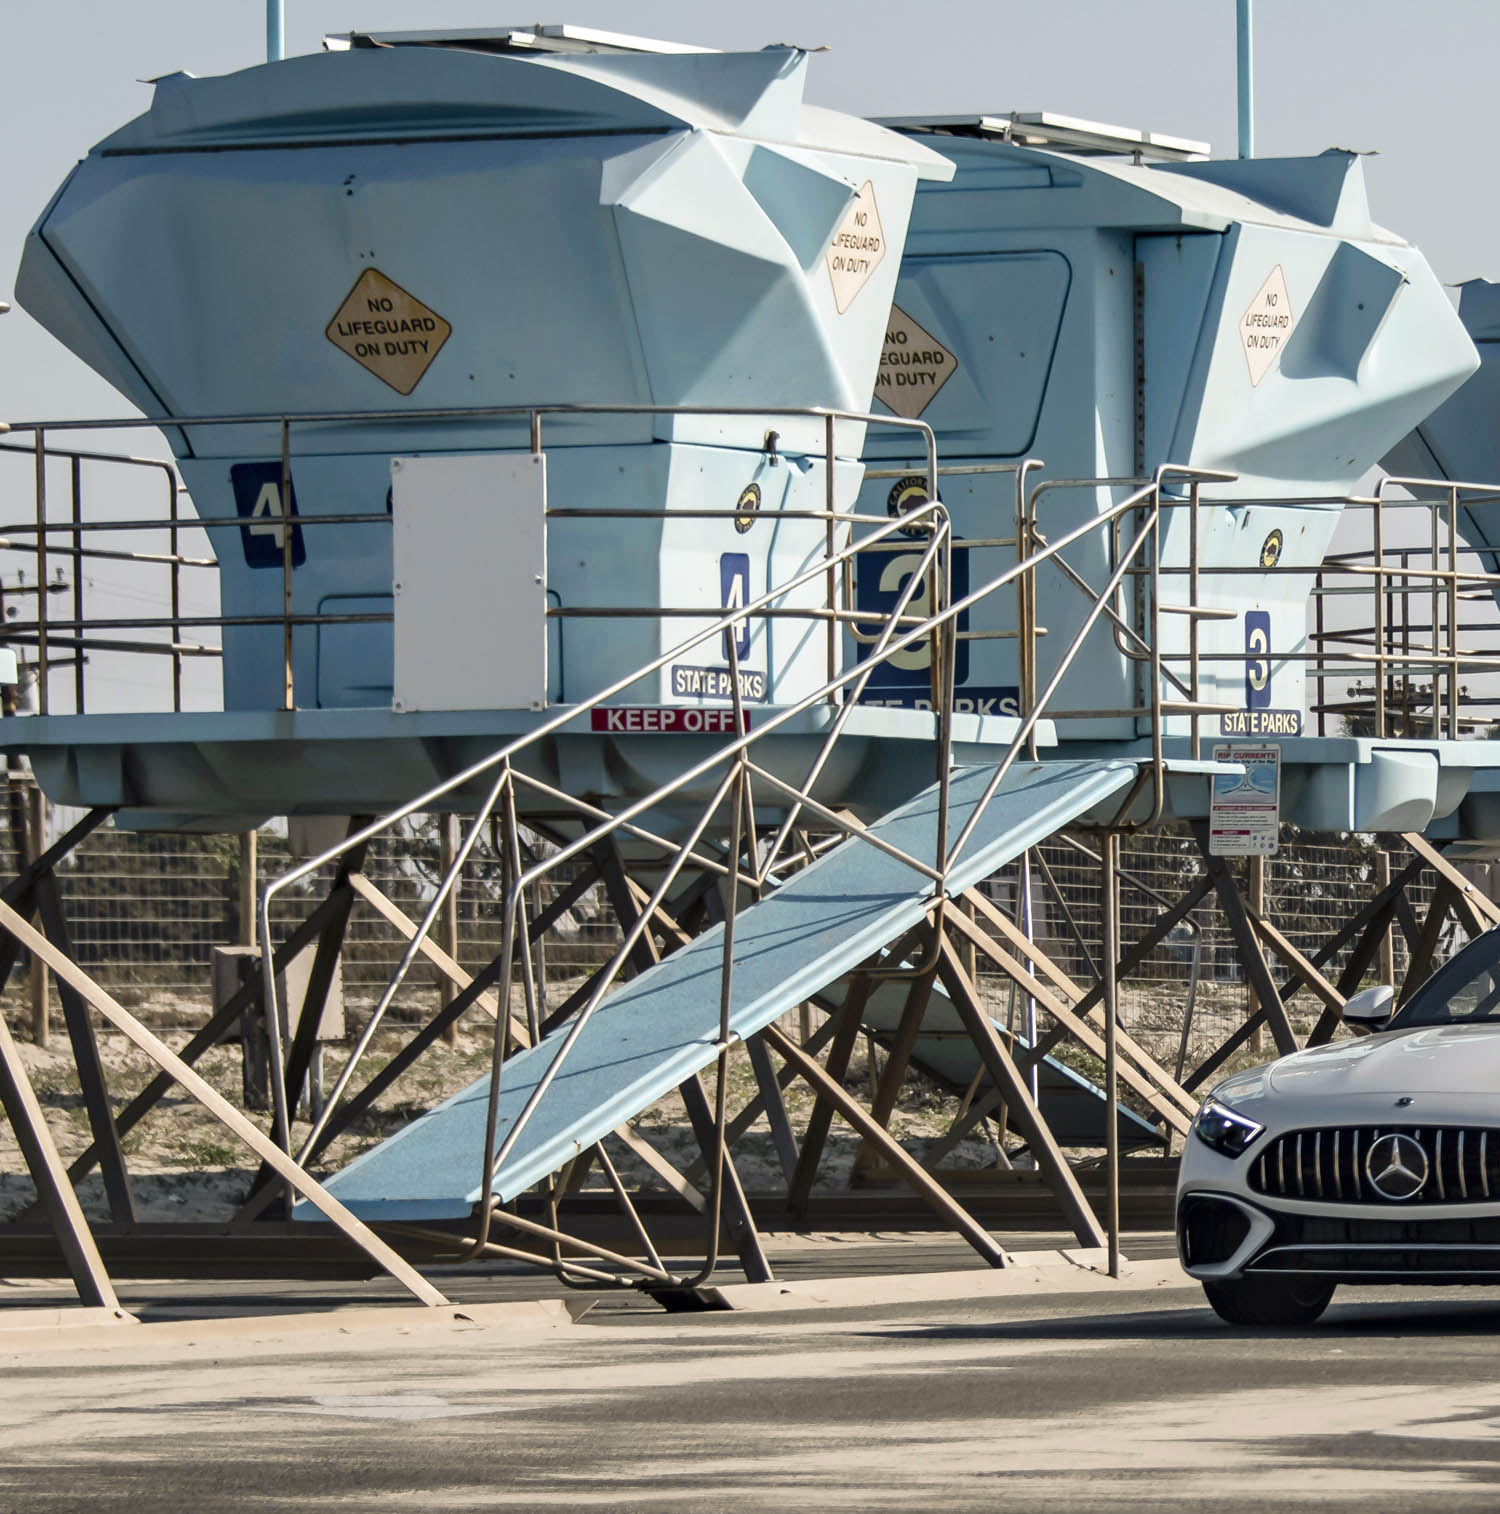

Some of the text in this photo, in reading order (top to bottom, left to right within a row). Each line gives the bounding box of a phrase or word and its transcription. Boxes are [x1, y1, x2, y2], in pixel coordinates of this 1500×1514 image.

[855, 211, 868, 227] NO
[832, 256, 870, 273] ON DUTY
[367, 298, 393, 312] NO
[1265, 294, 1278, 307] NO
[338, 317, 436, 336] LIFEGUARD
[1245, 314, 1289, 328] LIFEGUARD
[885, 331, 908, 345] NO
[1247, 335, 1280, 349] ON DUTY
[355, 340, 429, 357] ON DUTY
[895, 372, 937, 386] DUTY
[249, 483, 287, 549] 4
[726, 573, 748, 643] 4
[879, 554, 938, 671] 3
[1249, 628, 1268, 691] 3
[676, 669, 717, 694] STATE
[607, 710, 736, 732] KEEP OFF
[1224, 711, 1298, 734] STATE PARKS
